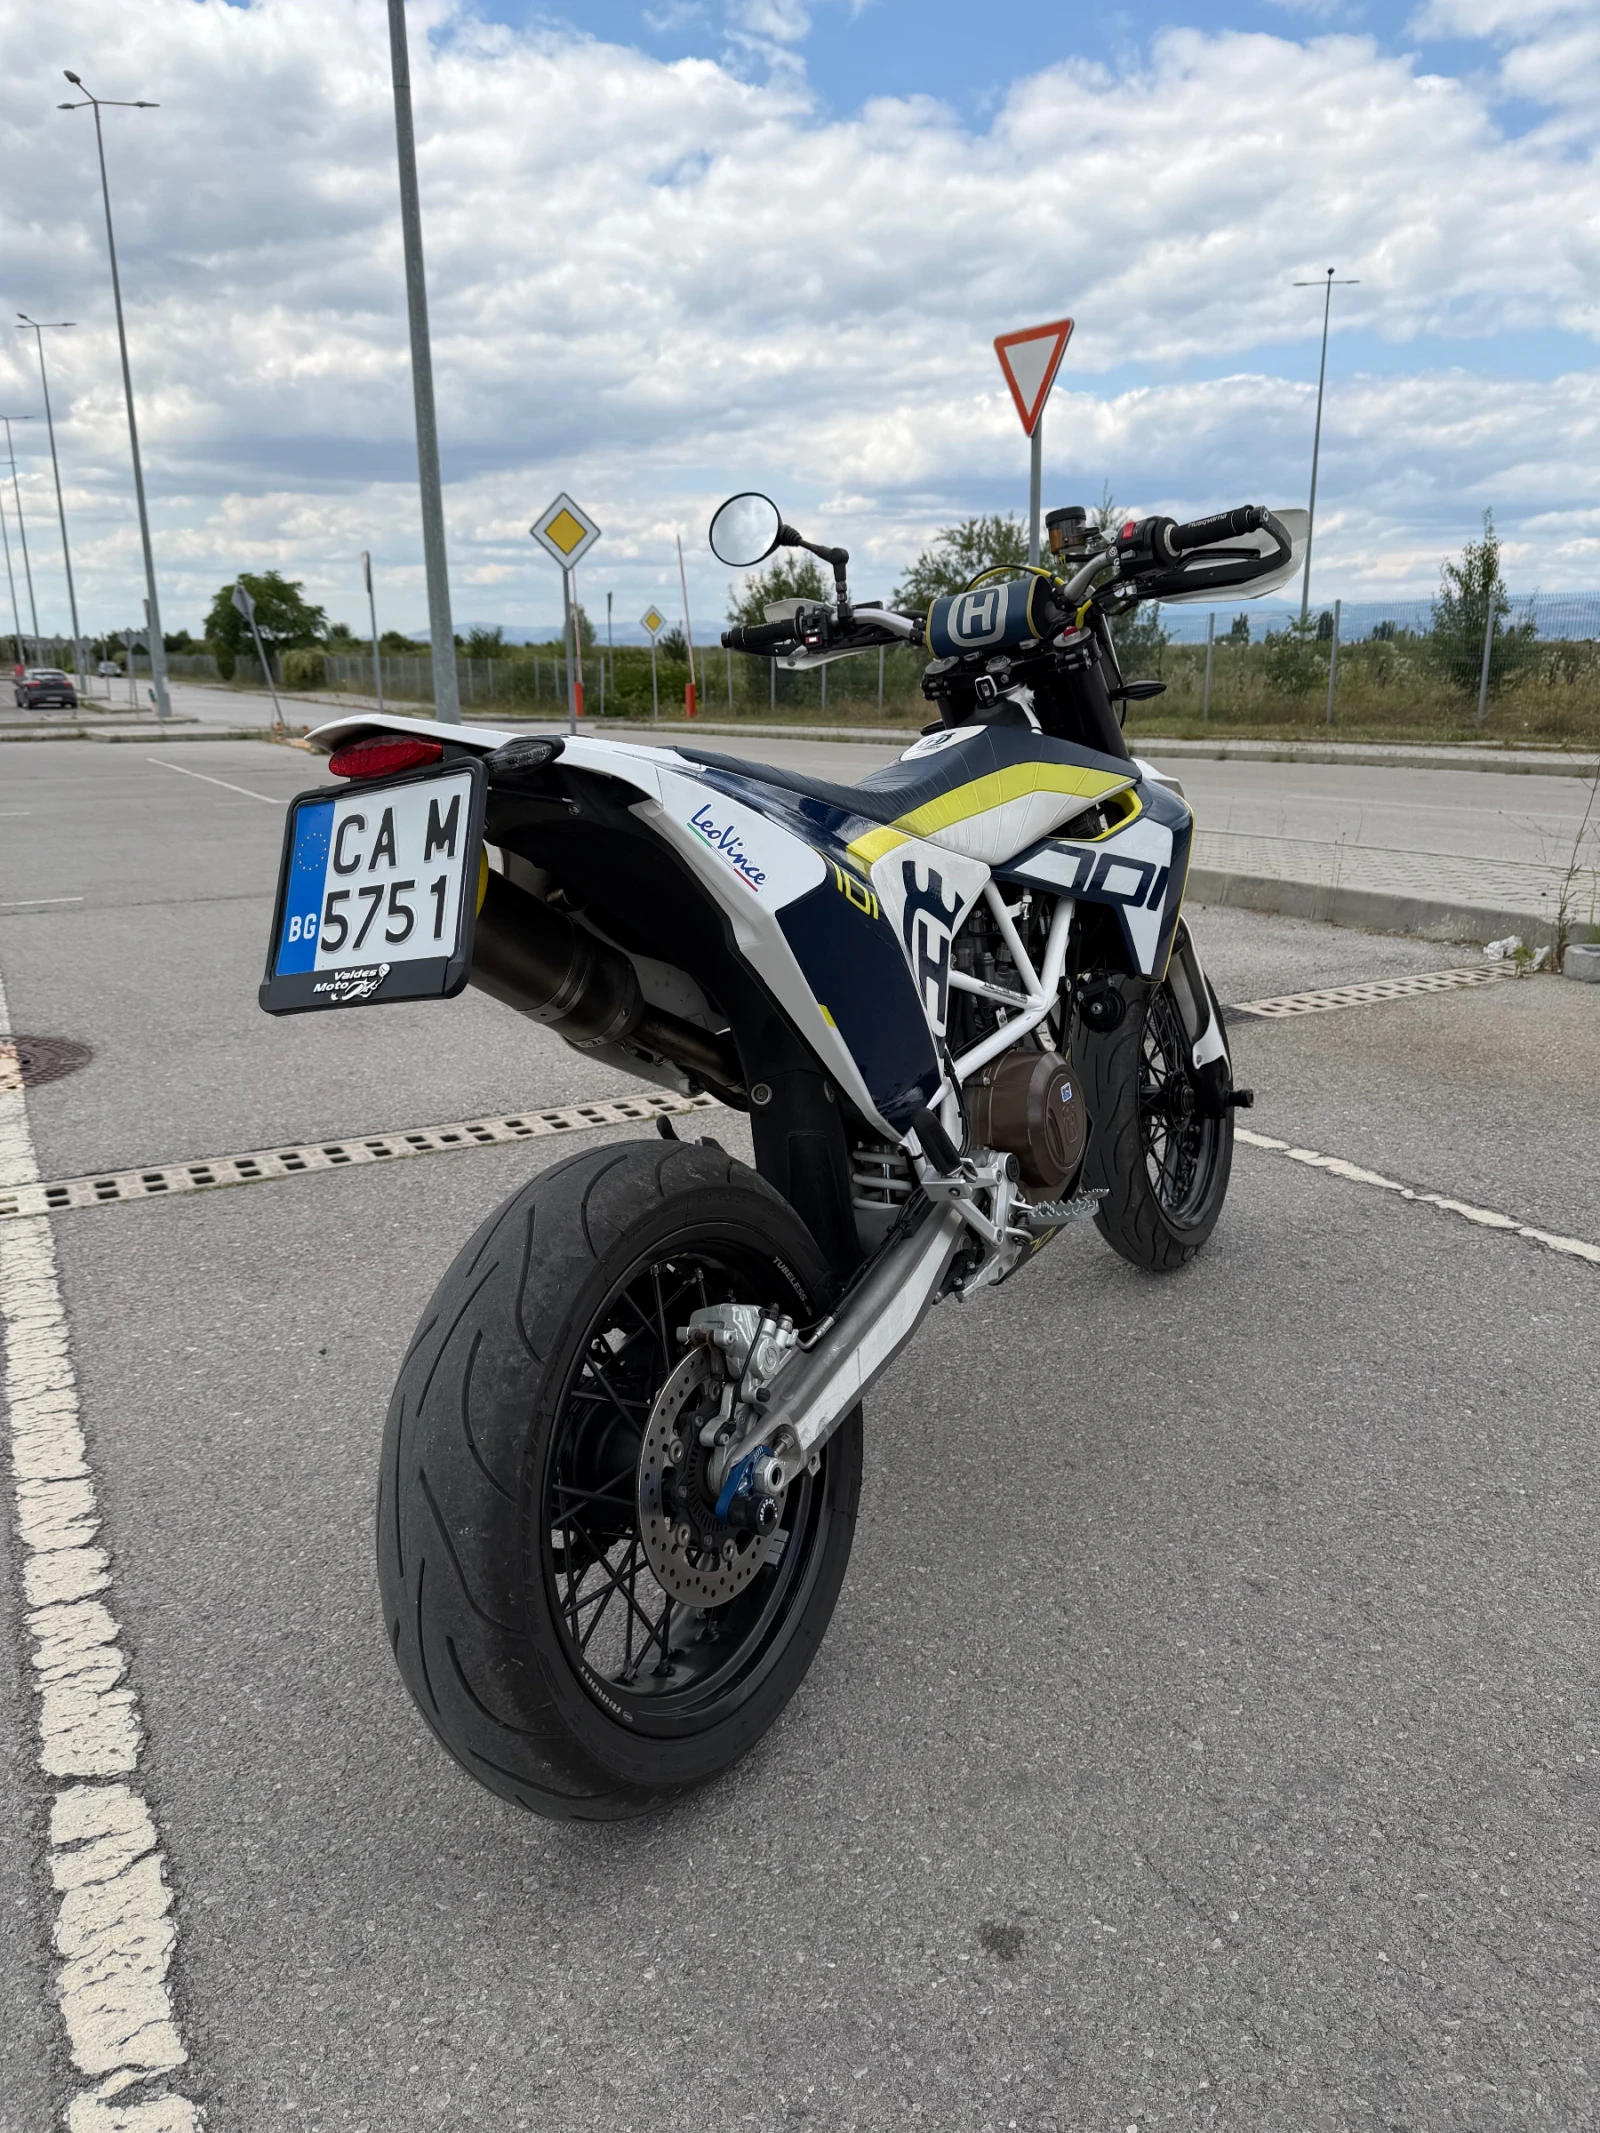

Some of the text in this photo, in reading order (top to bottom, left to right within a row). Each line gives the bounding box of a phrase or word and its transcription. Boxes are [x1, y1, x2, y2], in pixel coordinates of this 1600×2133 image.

[333, 794, 461, 875] CA M
[690, 803, 767, 886] LeoVince
[288, 913, 317, 943] BG
[320, 874, 448, 952] 5751
[312, 980, 350, 993] Moto
[334, 968, 378, 981] Valdes
[772, 1256, 808, 1302] TUBELESS
